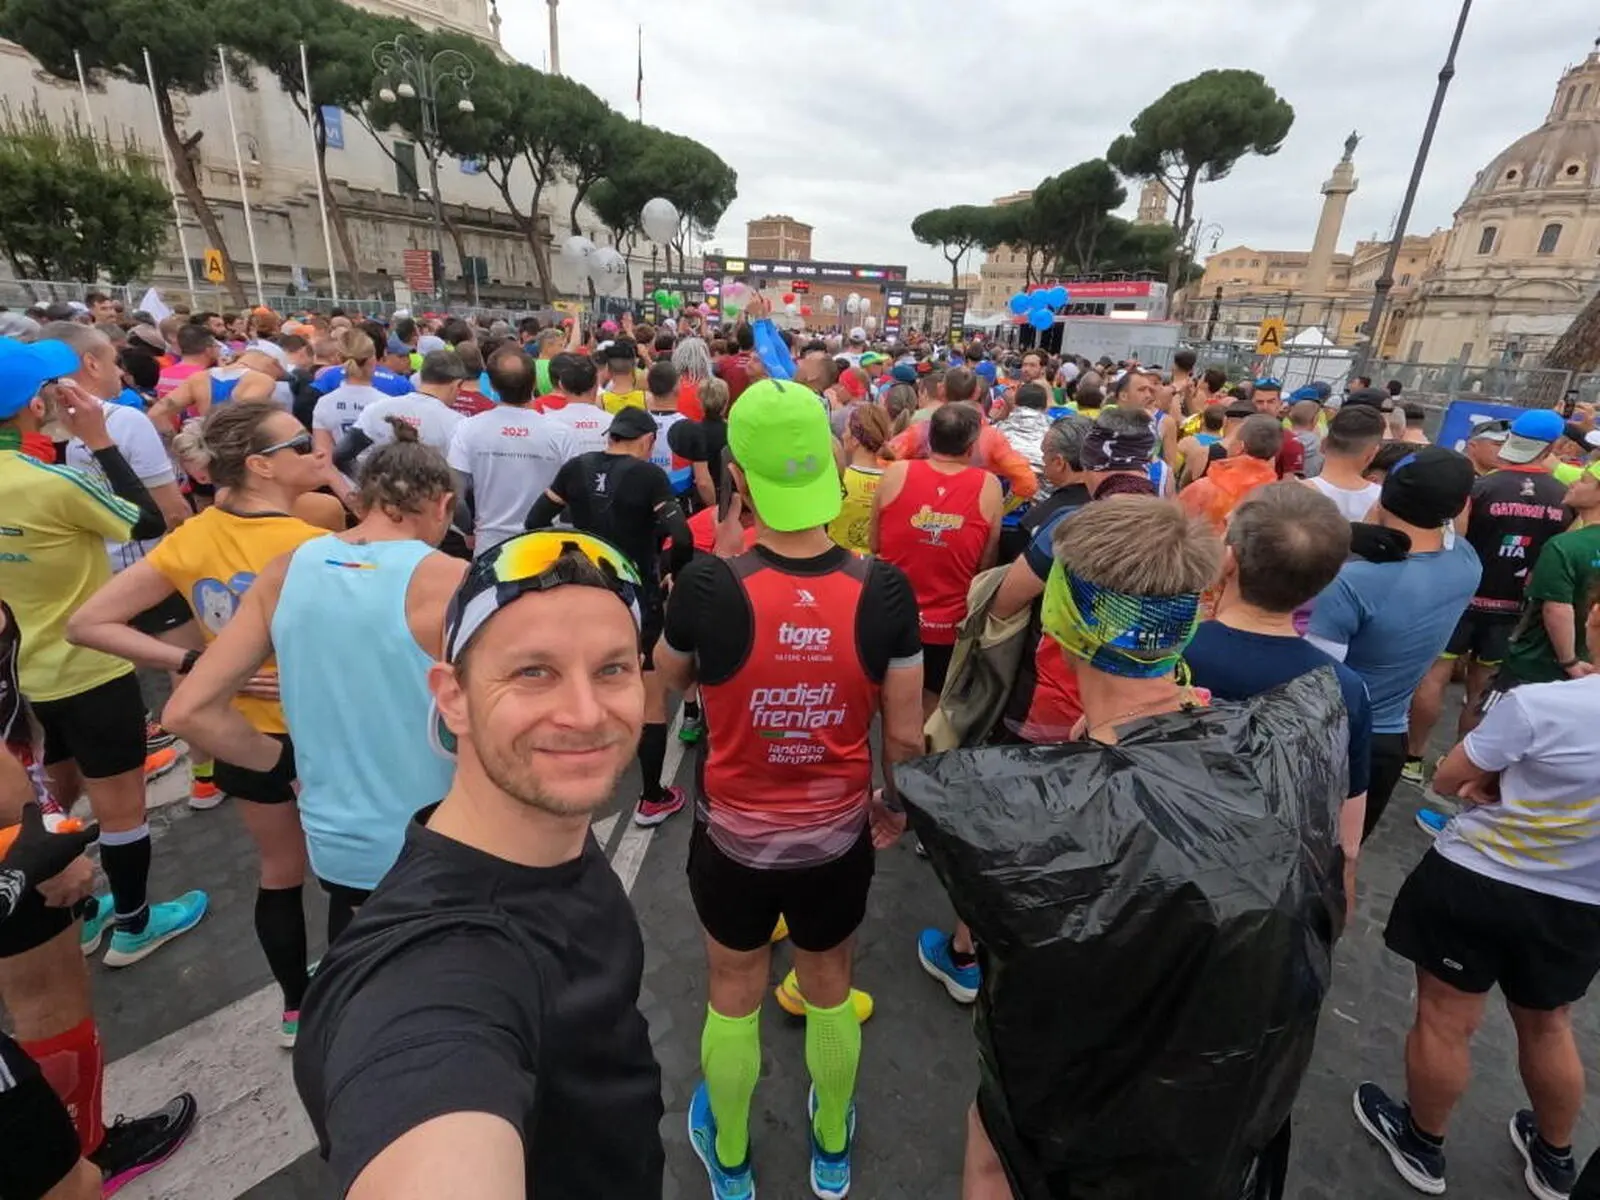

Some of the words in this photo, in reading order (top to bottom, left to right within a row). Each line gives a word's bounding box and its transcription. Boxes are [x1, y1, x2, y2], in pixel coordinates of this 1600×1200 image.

[209, 256, 222, 273] A
[1260, 326, 1278, 346] A
[1498, 544, 1526, 559] ITA
[778, 622, 832, 650] tigre
[749, 682, 837, 711] podisti
[752, 703, 847, 728] frentani
[768, 743, 825, 755] lanciano
